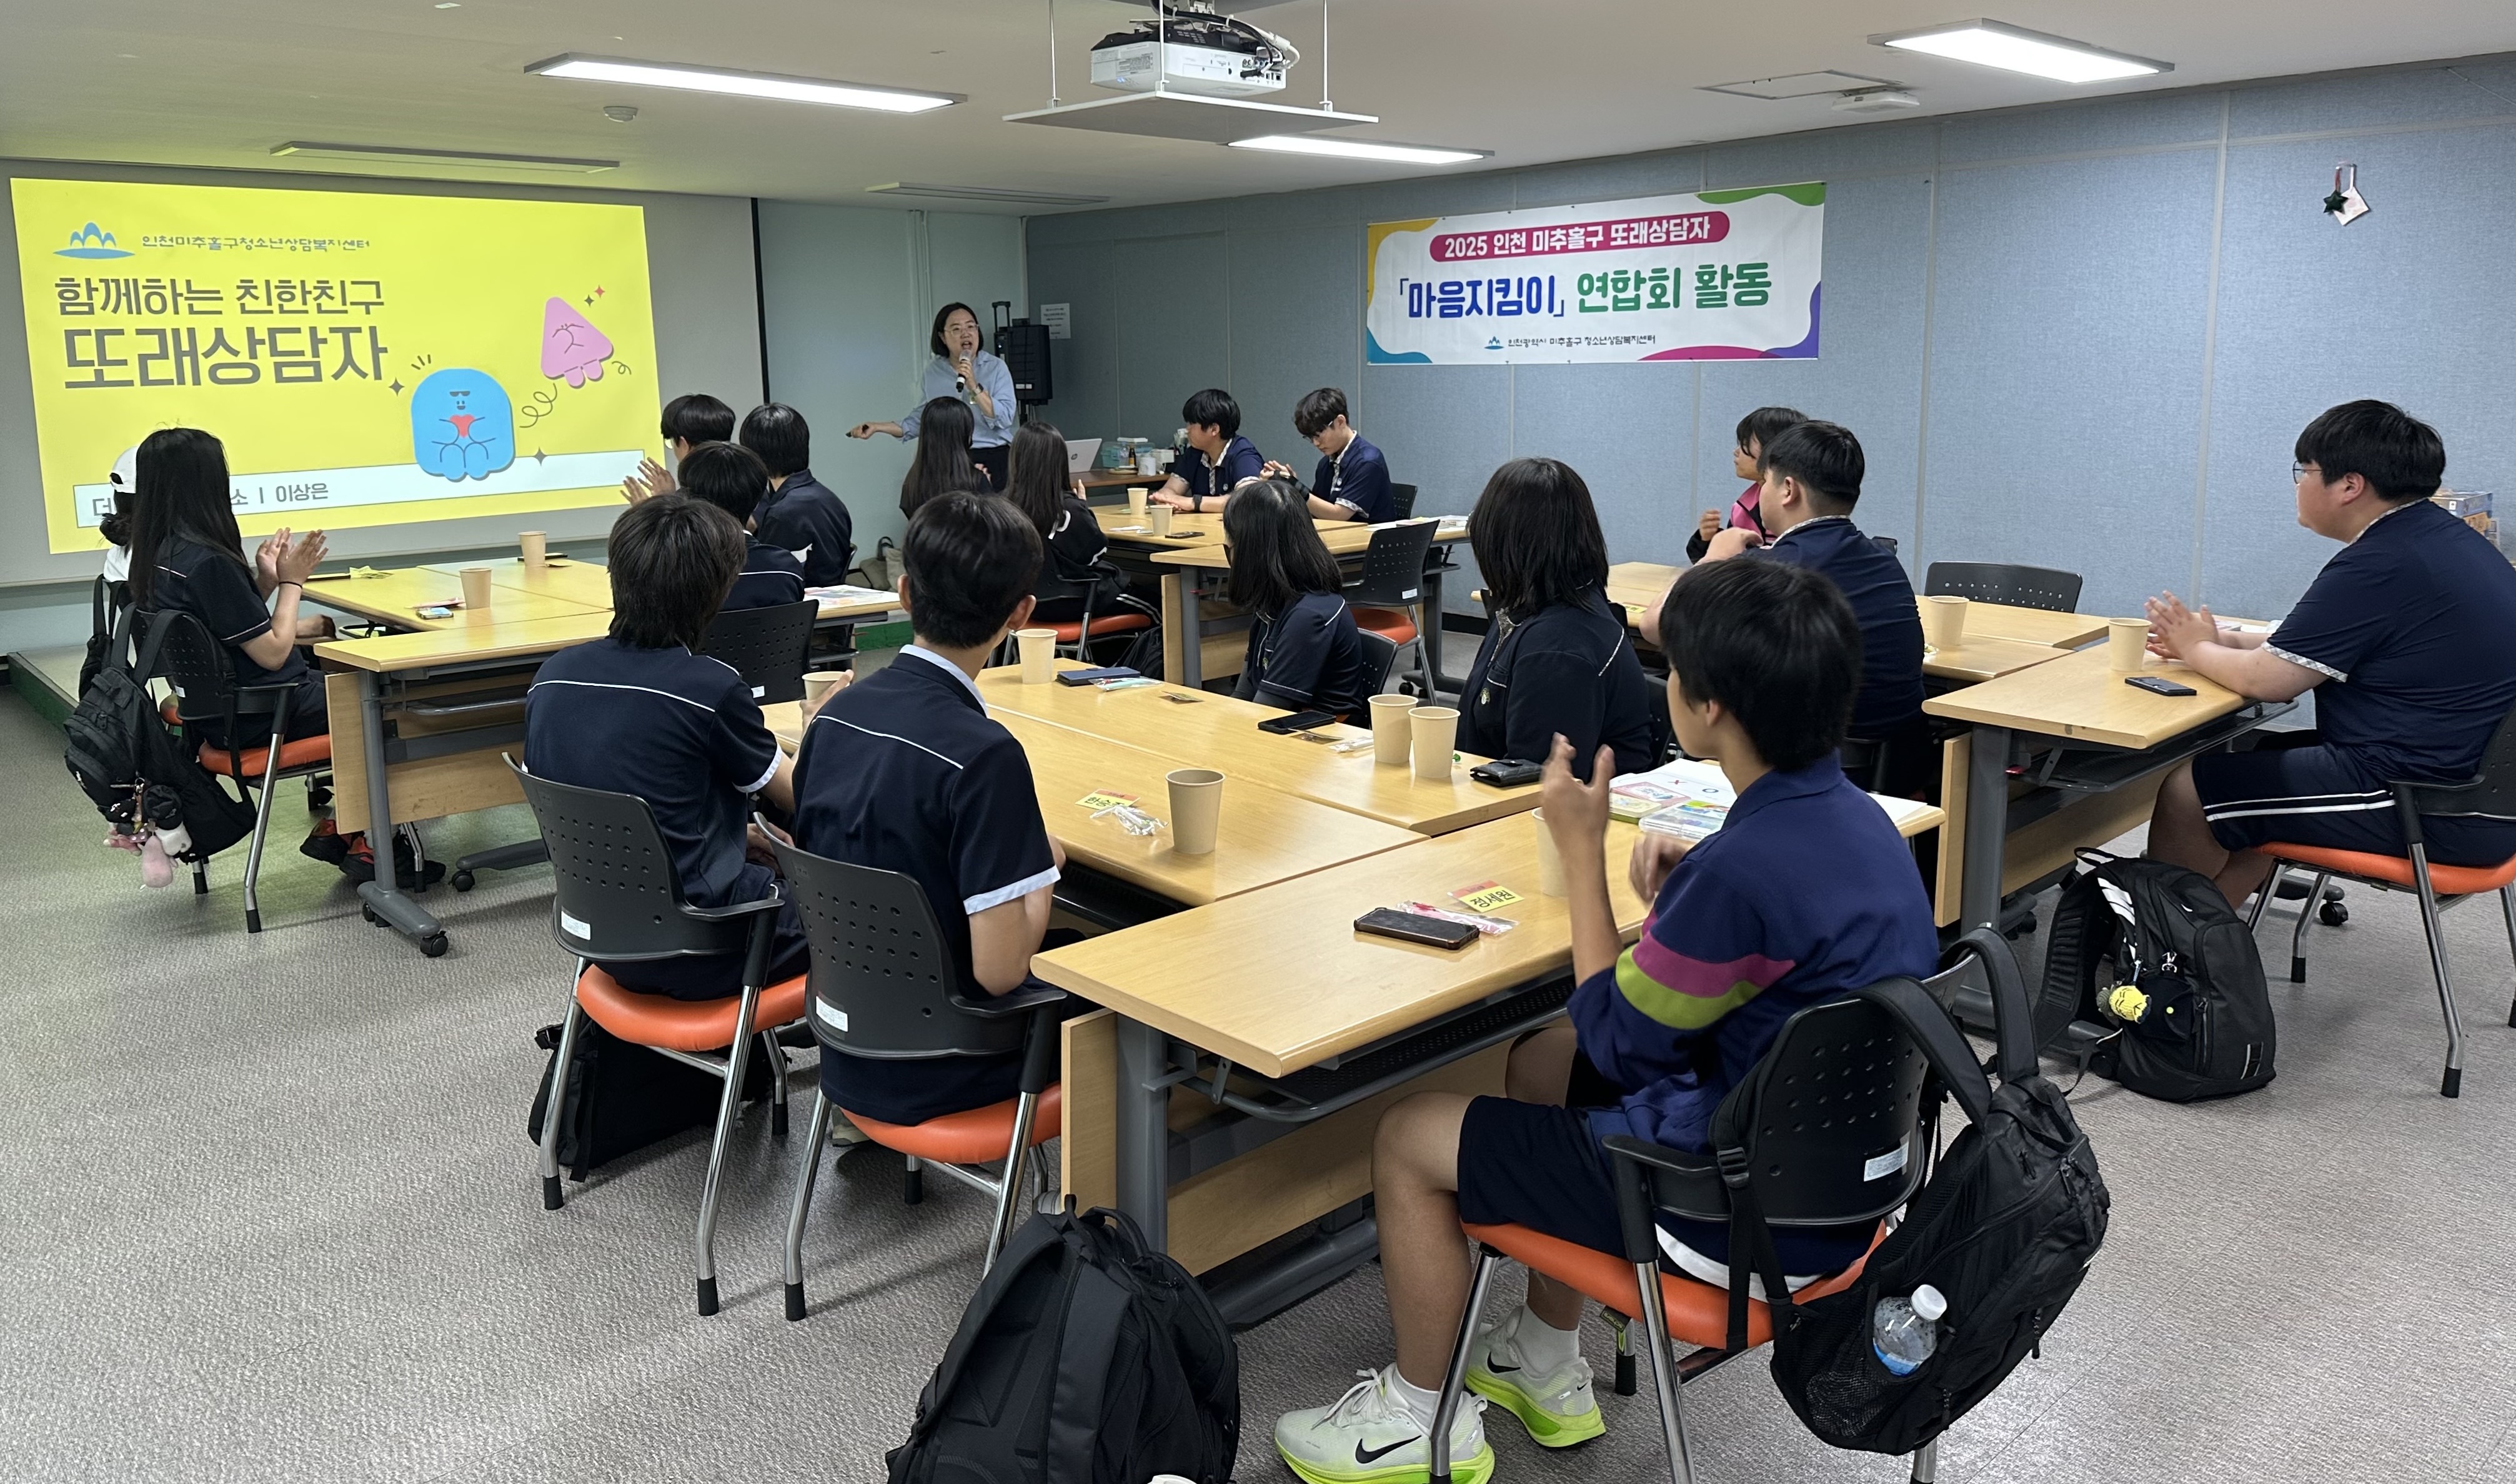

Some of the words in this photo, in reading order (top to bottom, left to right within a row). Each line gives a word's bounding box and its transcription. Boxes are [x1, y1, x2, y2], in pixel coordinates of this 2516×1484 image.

[142, 235, 370, 253] 인천미추홀구청소년상담복지센터
[1445, 235, 1488, 258] 2025
[1493, 232, 1527, 256] 인천
[1532, 225, 1604, 252] 미추홀구
[1609, 215, 1710, 246] 또래상담자
[54, 277, 224, 316] 함께하는
[236, 279, 385, 315] 친한친구
[1577, 267, 1681, 313] 연합회
[1694, 262, 1773, 309] 활동
[1508, 338, 1547, 348] 인천광역시
[1549, 337, 1583, 347] 미추홀구
[1584, 335, 1656, 346] 청소년상담복지센터
[64, 325, 389, 389] 또래상담자
[275, 482, 329, 503] 이상은
[1469, 889, 1516, 908] 정세원
